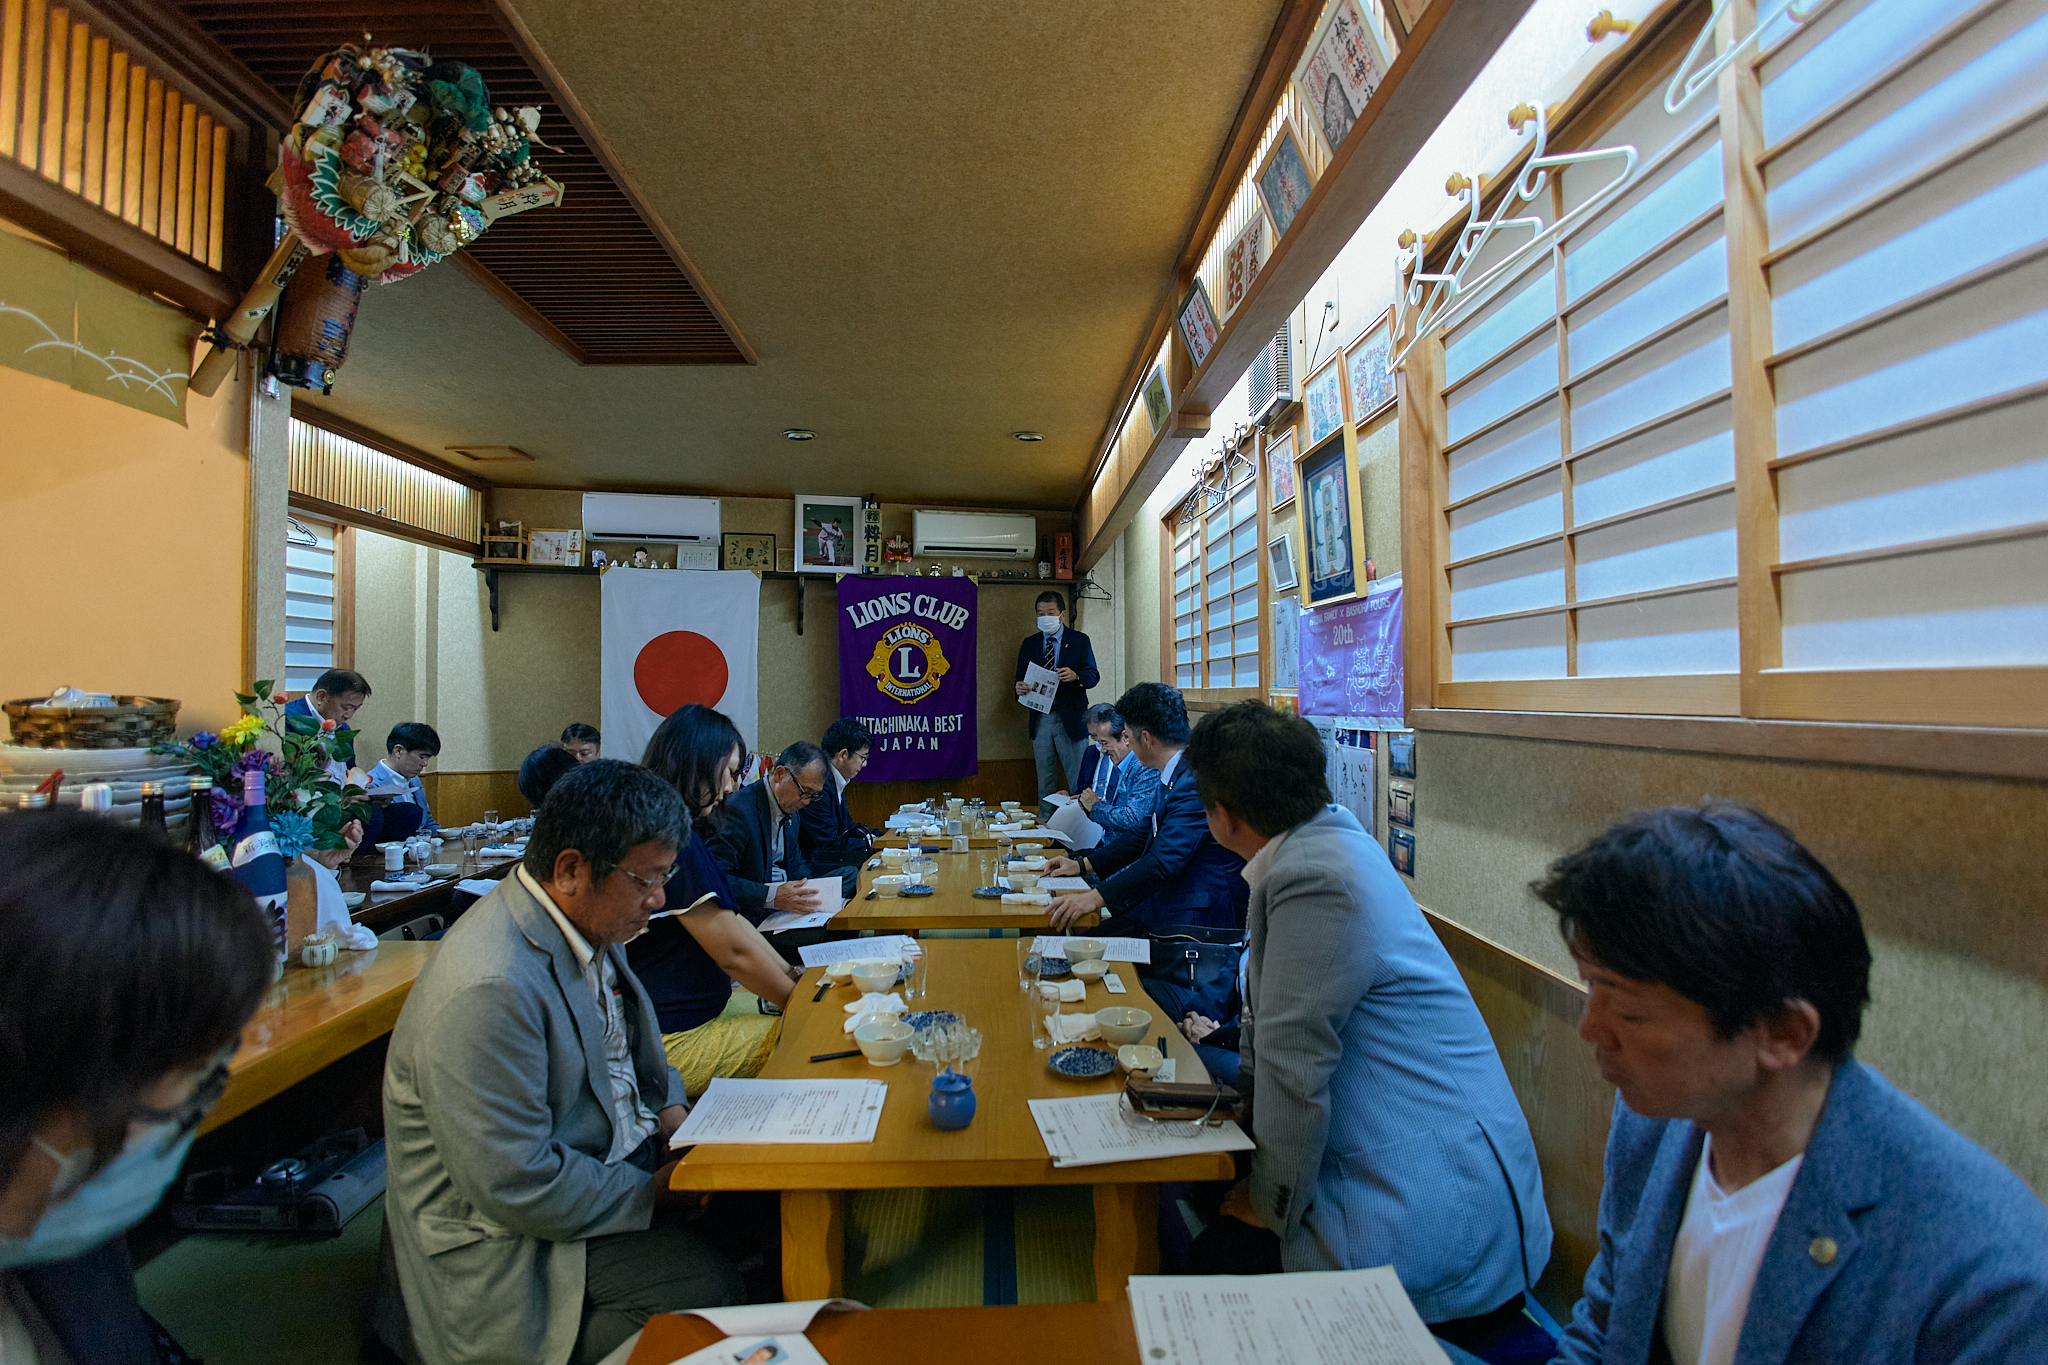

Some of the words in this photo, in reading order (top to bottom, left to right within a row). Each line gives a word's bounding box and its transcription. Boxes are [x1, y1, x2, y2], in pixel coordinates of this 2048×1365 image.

[846, 591, 911, 629] LIONS
[914, 594, 970, 631] CLUB
[1371, 597, 1391, 611] TOURS
[886, 626, 930, 644] LIONS
[1333, 623, 1354, 646] 20th
[897, 646, 922, 678] L
[884, 681, 933, 697] INTERNATIONAL
[855, 715, 930, 735] ITACHINAKA
[934, 714, 964, 733] BEST
[879, 736, 939, 752] JAPAN
